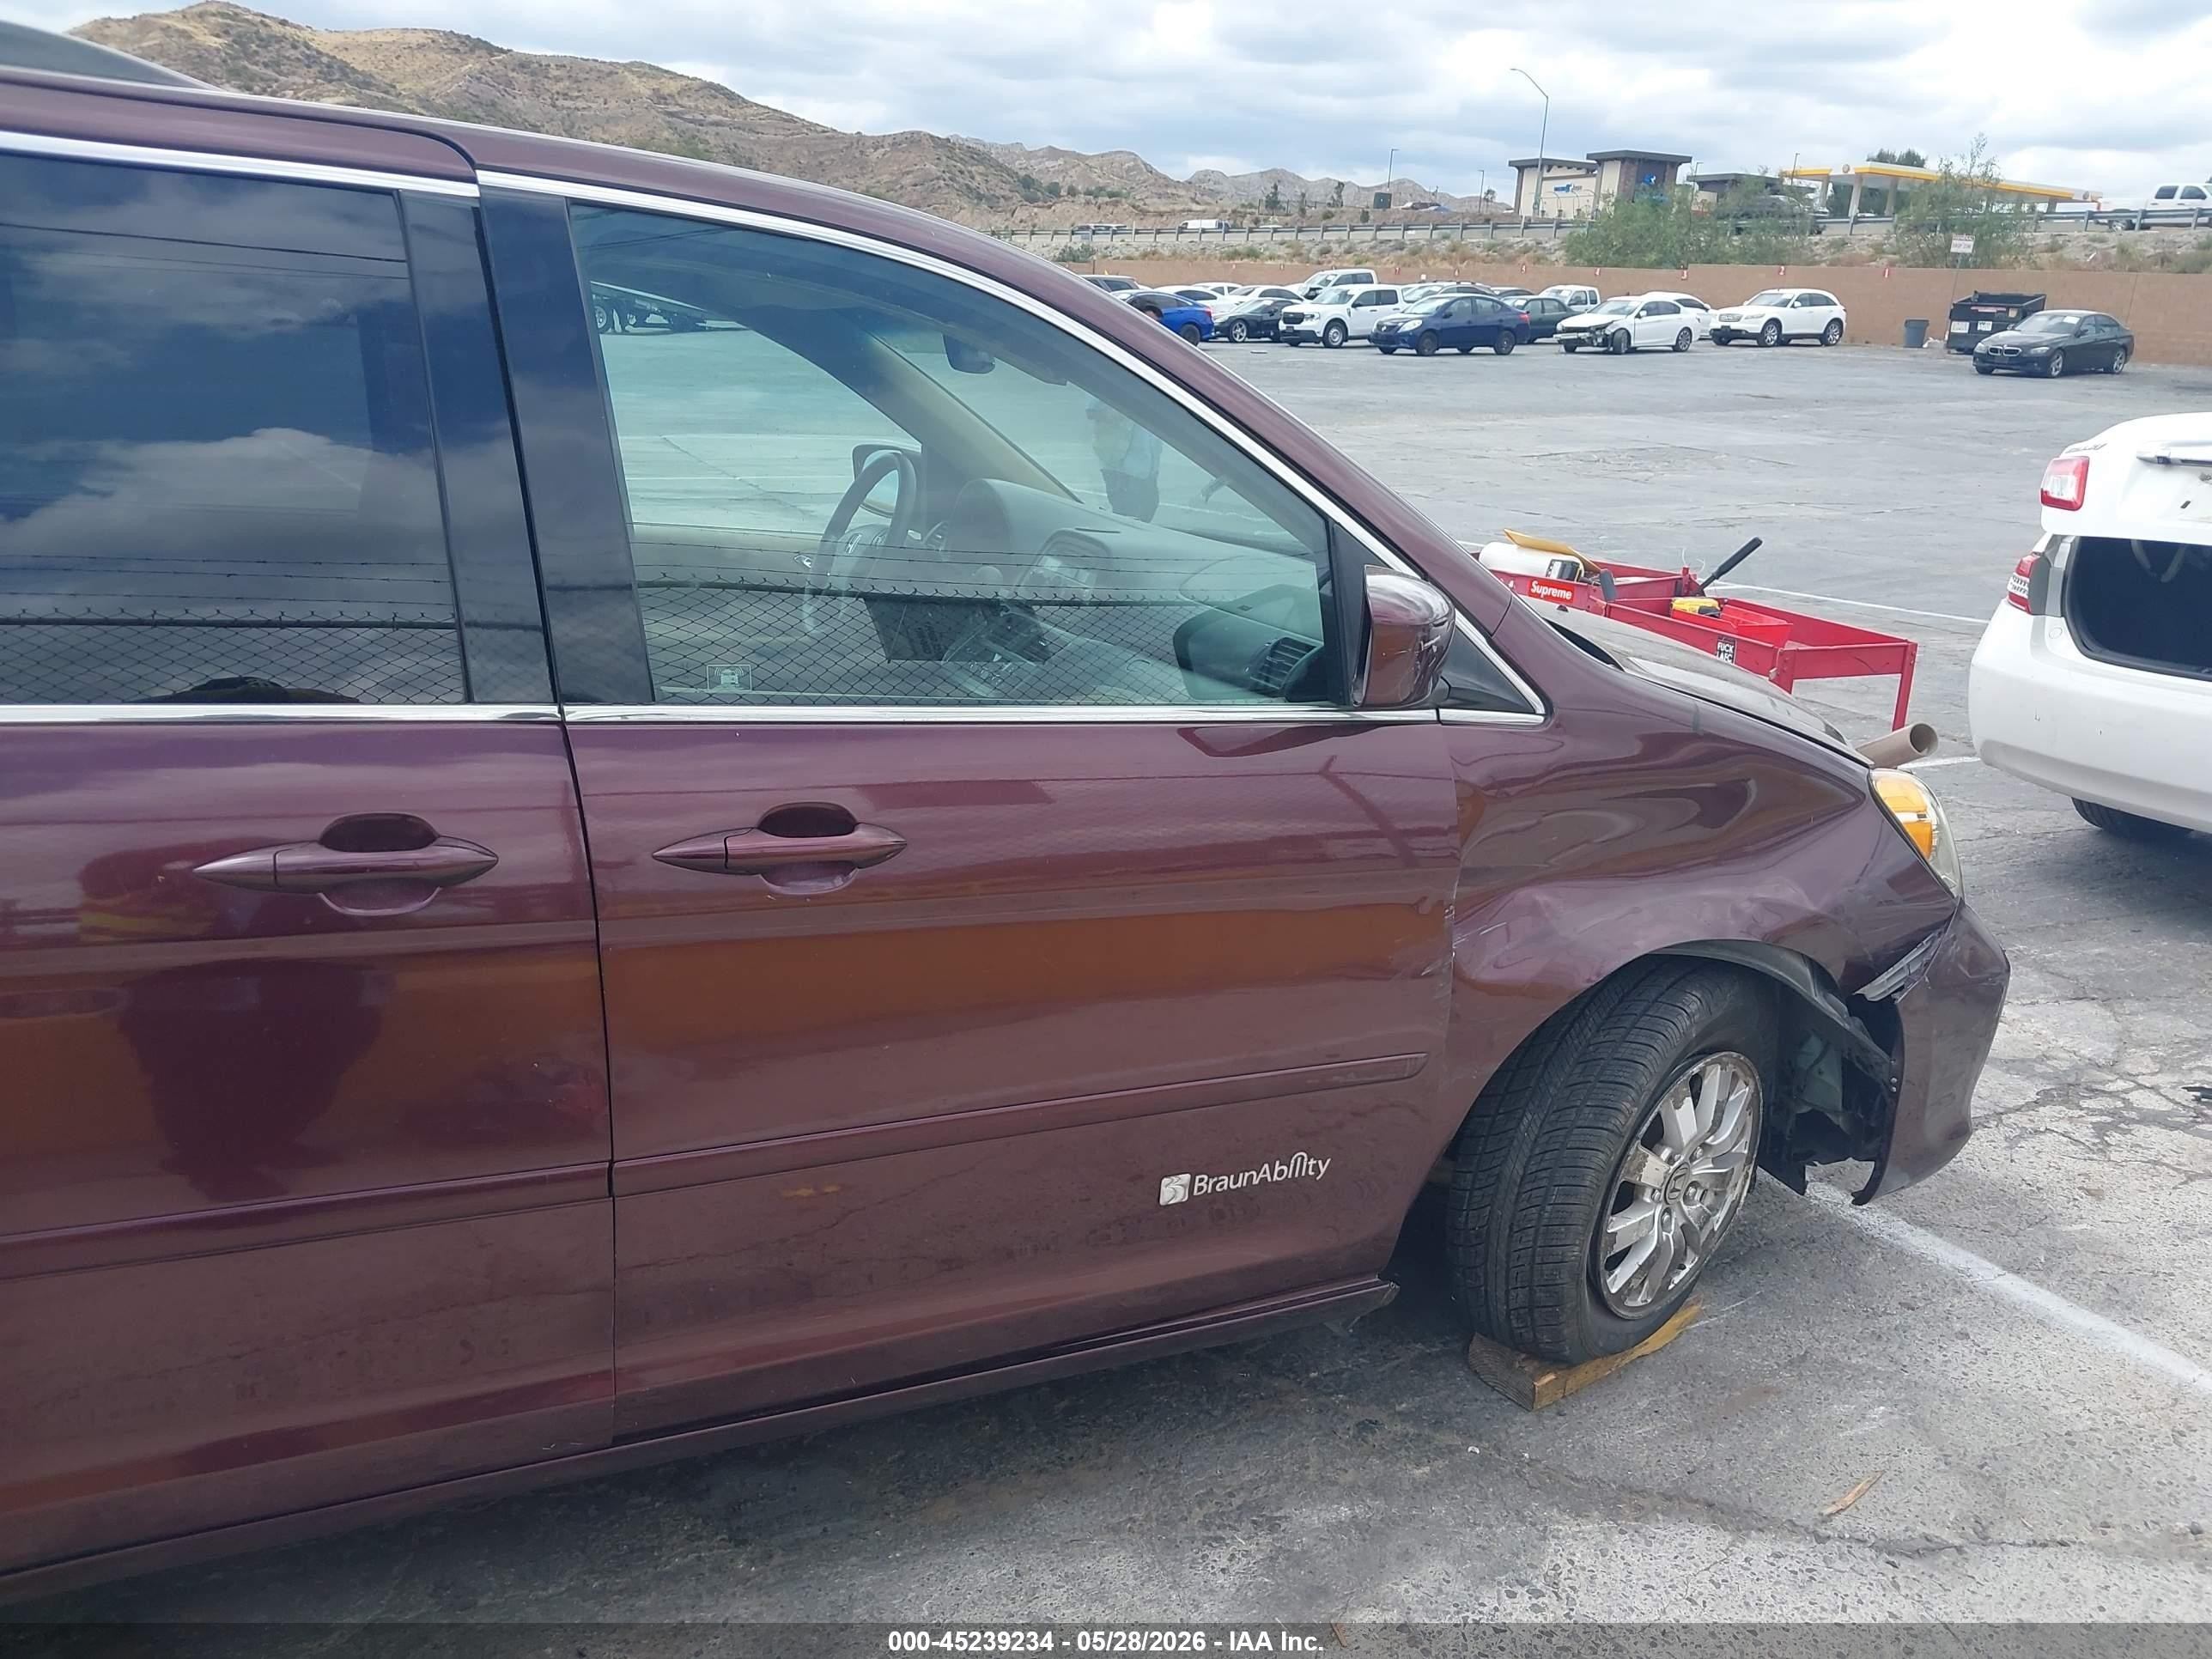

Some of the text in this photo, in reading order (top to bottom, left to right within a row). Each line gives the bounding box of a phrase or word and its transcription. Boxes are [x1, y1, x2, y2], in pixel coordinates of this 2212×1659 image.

[1530, 580, 1573, 600] Supreme
[1717, 641, 1735, 653] FUCK
[1193, 1152, 1332, 1197] BraunAbility
